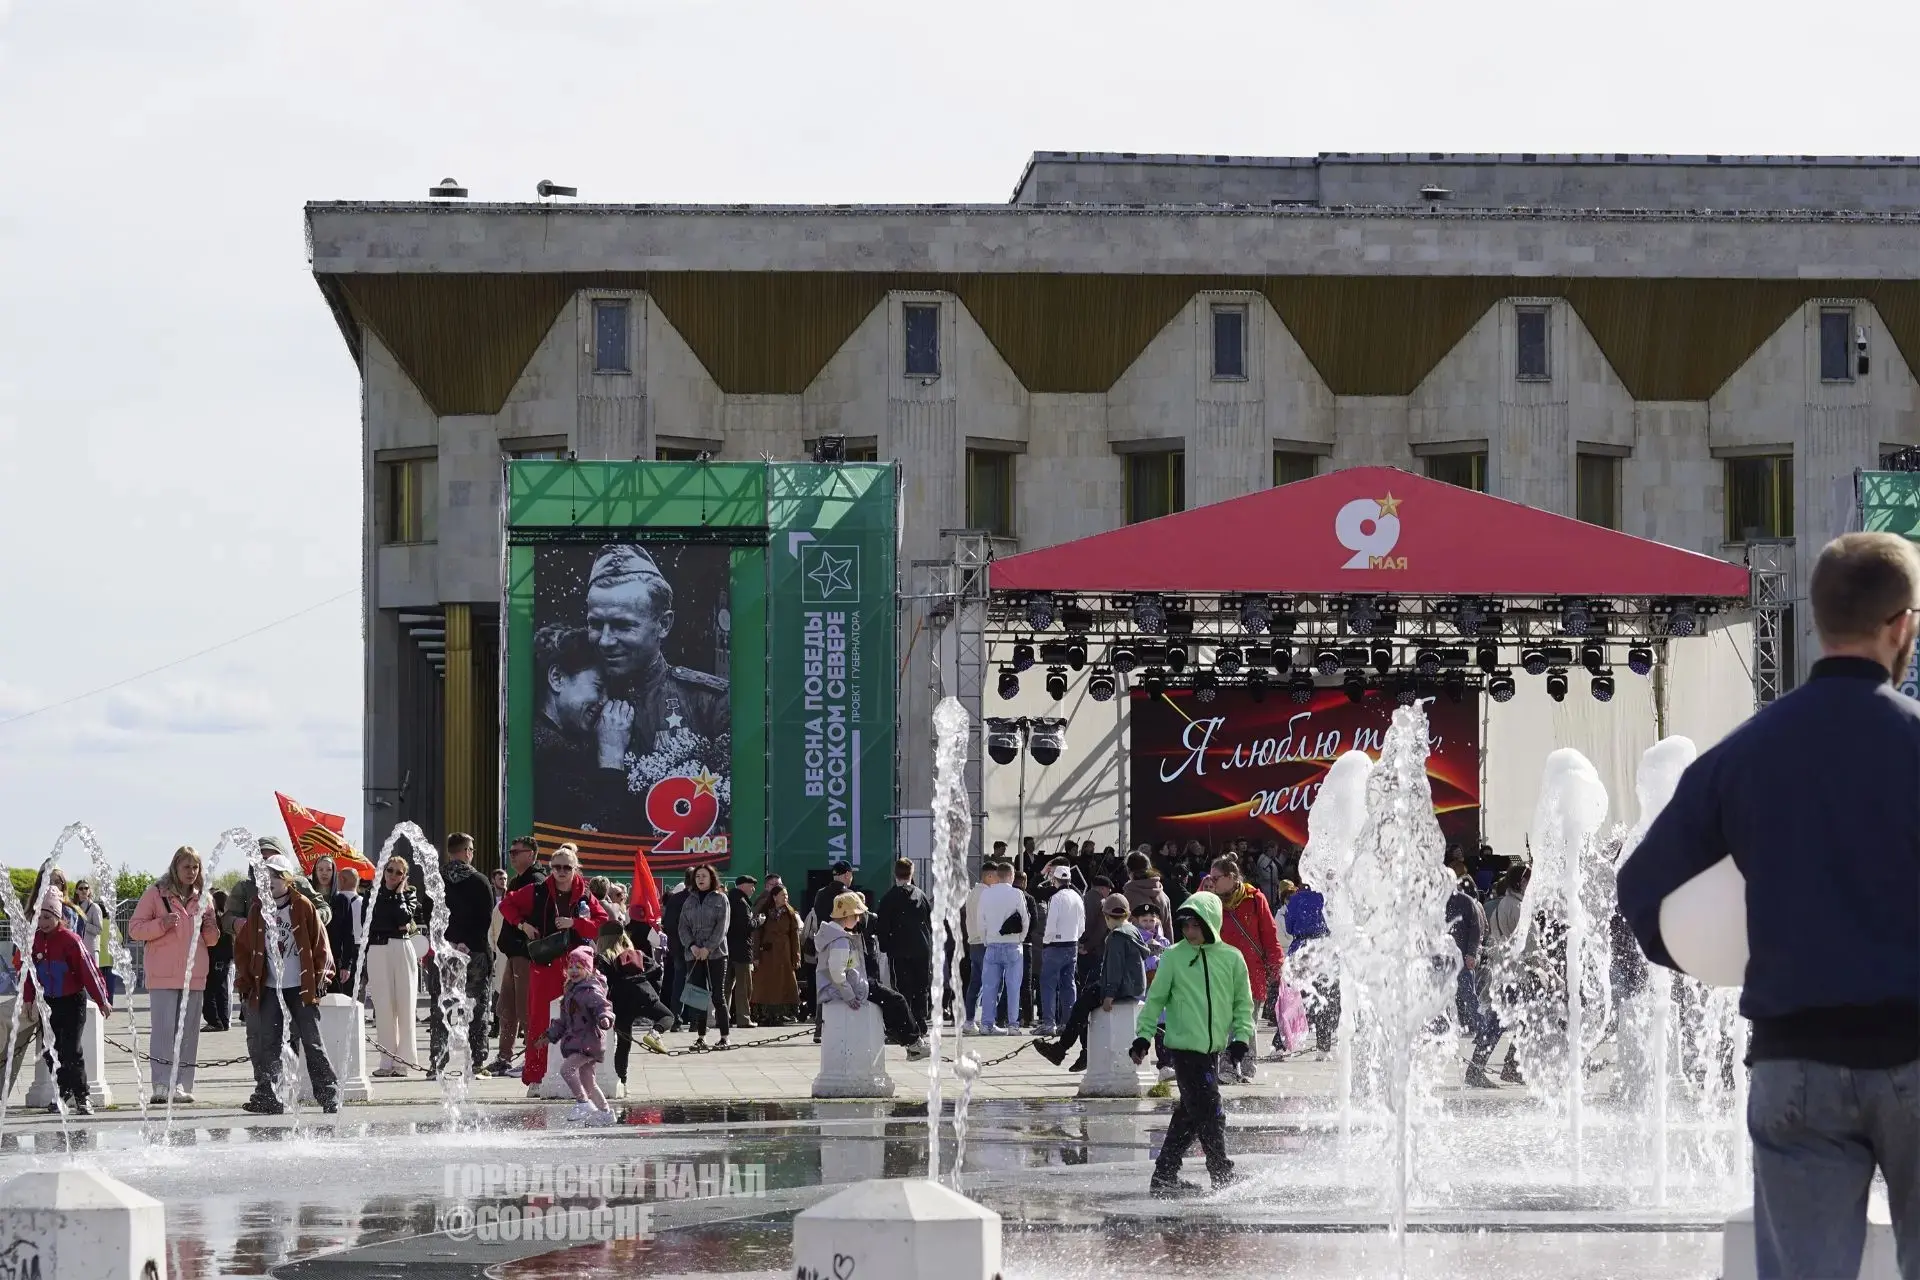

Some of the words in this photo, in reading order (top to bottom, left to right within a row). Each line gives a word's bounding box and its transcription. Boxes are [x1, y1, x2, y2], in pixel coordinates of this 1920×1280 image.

[1335, 498, 1400, 569] 9
[1368, 556, 1408, 570] МАЯ
[804, 612, 825, 710] ПОБЕДЫ
[827, 612, 846, 699] СЕВЕРЕ
[852, 610, 860, 679] ГУБЕРНАТОРА
[852, 684, 860, 722] ПРОЕКТ
[804, 717, 824, 796] ВЕСНА
[828, 705, 847, 826] РУССКОМ
[1160, 716, 1226, 782] Я
[1221, 711, 1341, 770] люблю
[645, 775, 719, 853] 9
[683, 836, 728, 853] МАЯ
[828, 833, 847, 866] НА
